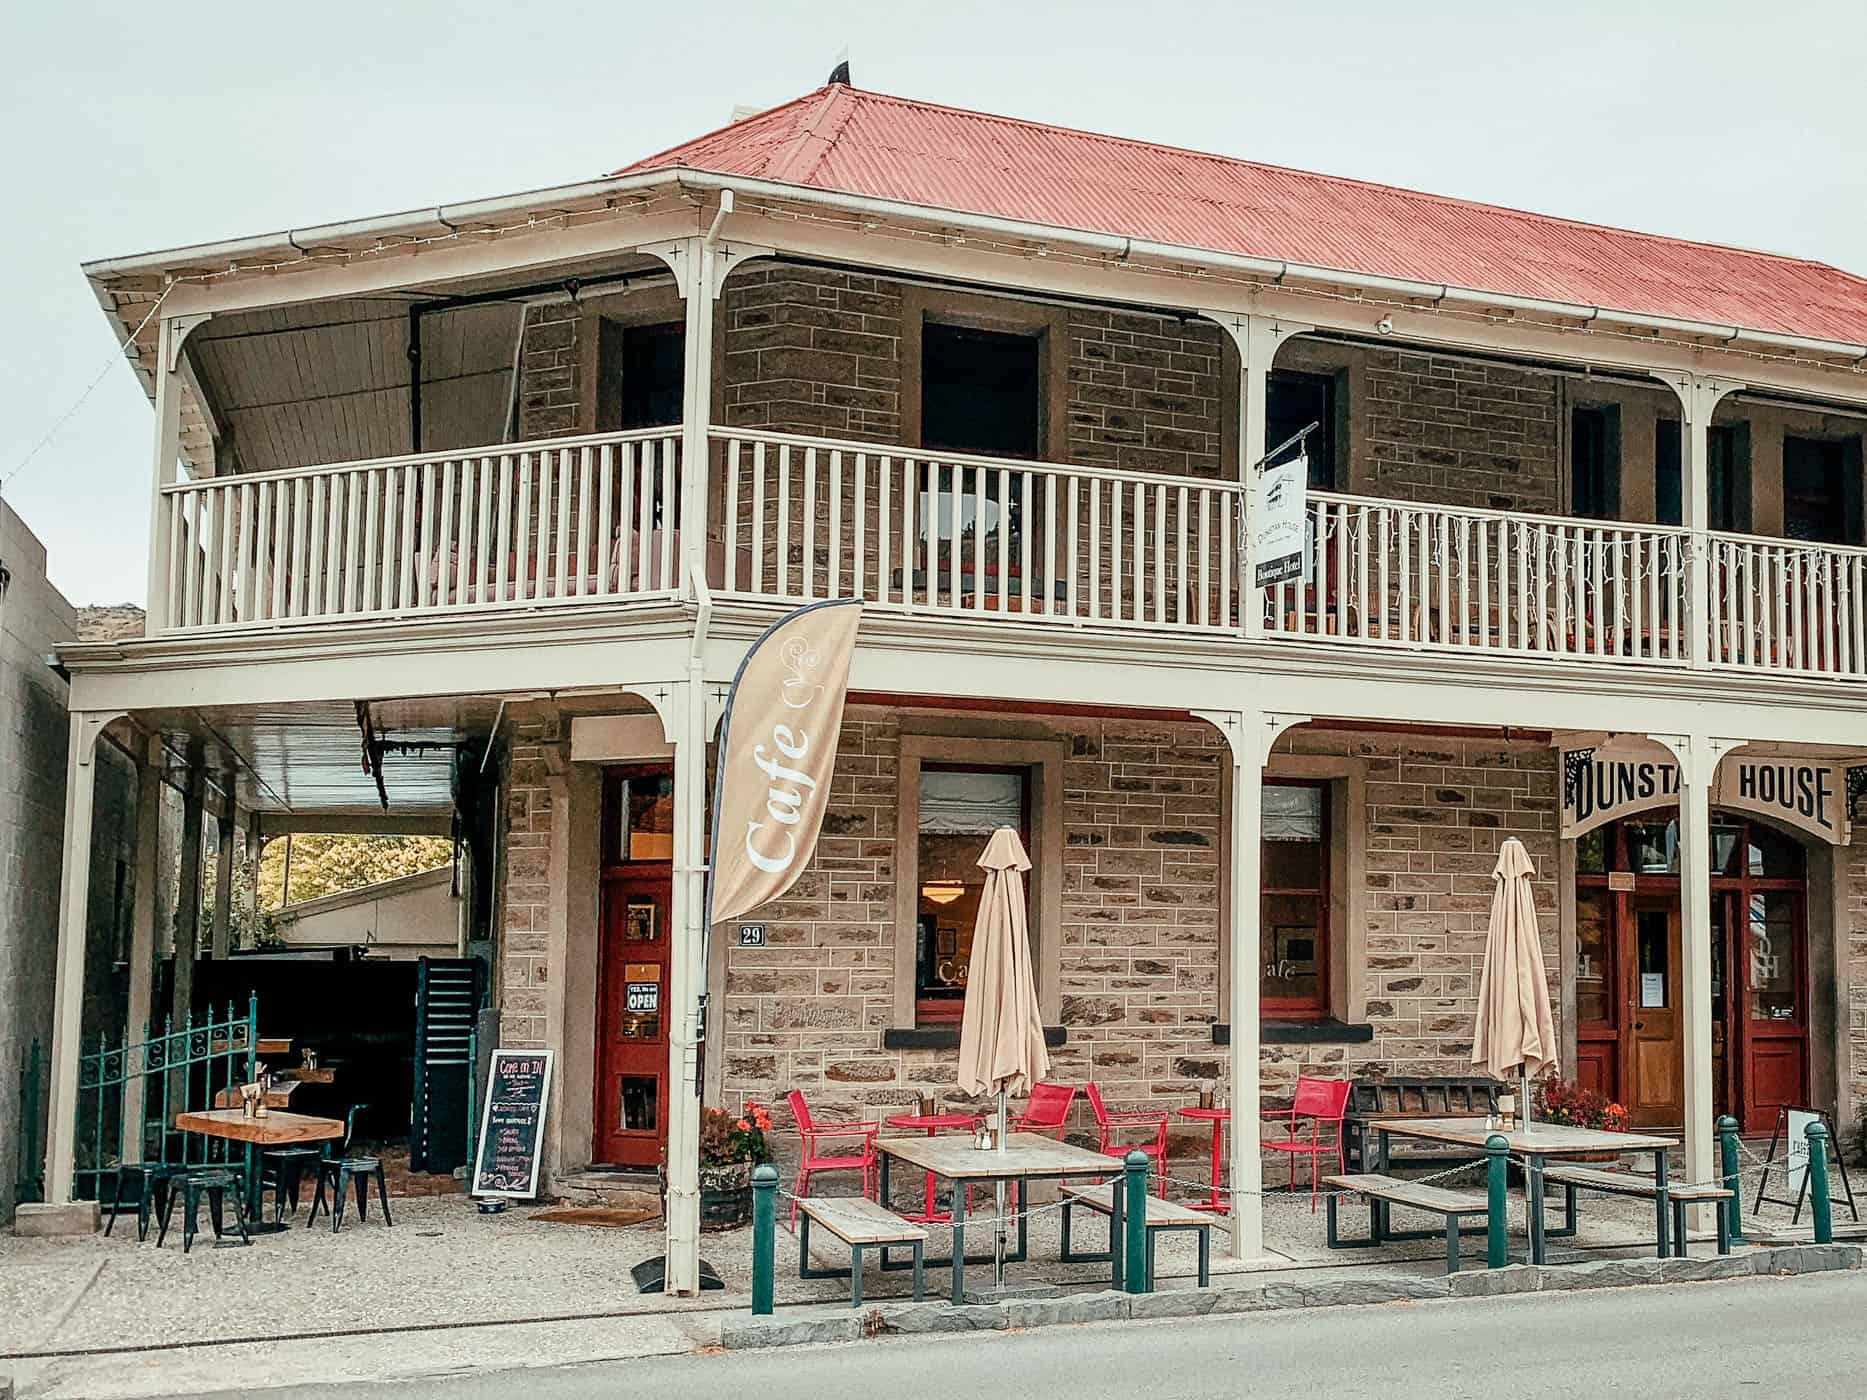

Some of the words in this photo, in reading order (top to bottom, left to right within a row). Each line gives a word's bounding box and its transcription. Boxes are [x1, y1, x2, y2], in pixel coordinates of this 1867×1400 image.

[1284, 556, 1301, 574] Hotel
[745, 724, 817, 873] Cafe
[1740, 764, 1833, 831] HOUSE
[743, 927, 760, 944] 29
[630, 994, 657, 1009] OPEN
